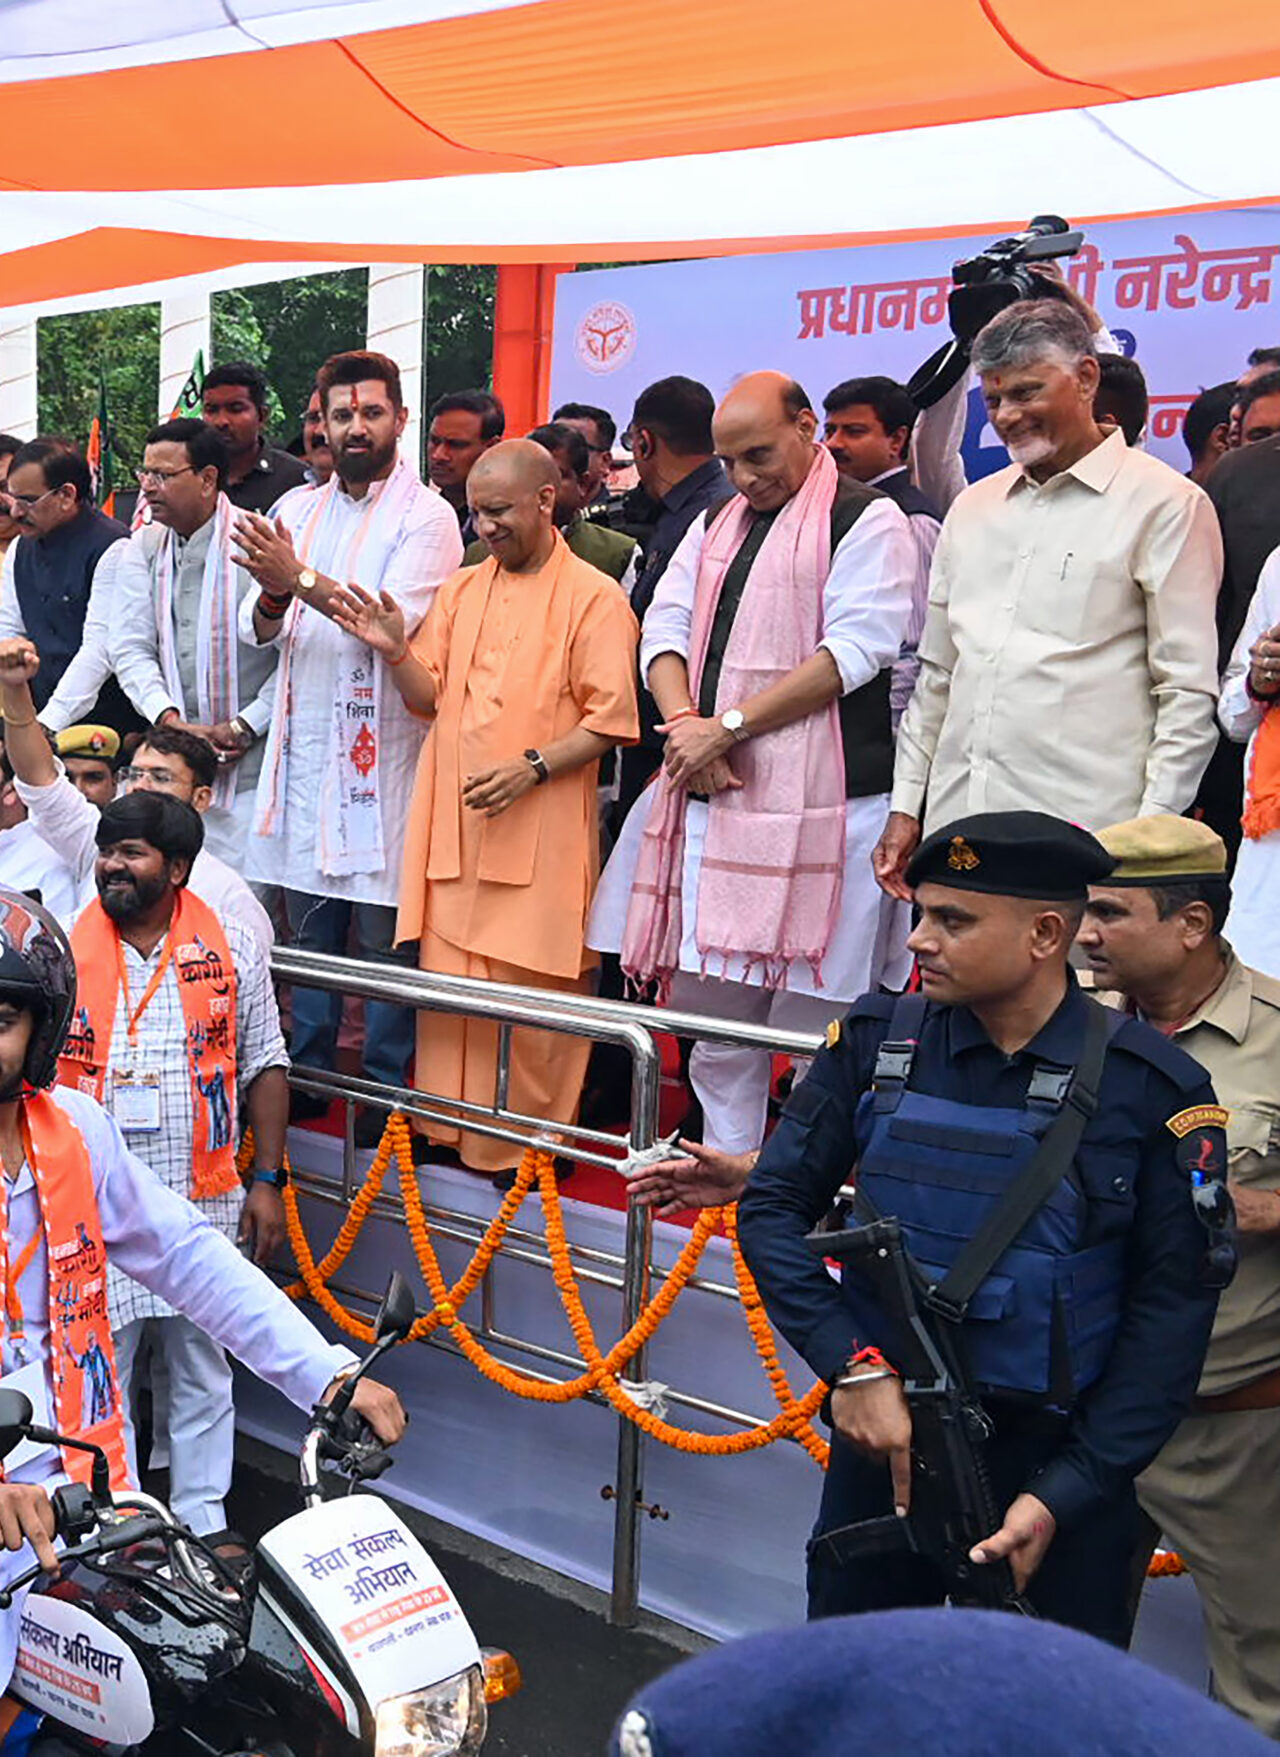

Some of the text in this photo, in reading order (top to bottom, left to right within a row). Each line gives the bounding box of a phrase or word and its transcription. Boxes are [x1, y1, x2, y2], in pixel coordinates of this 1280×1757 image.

[797, 277, 949, 339] प्रधानम
[1112, 234, 1276, 312] नरेन्द्र
[346, 701, 375, 719] शिवा
[353, 687, 373, 699] नम
[303, 1529, 408, 1580] सेवा संकल्प
[344, 1561, 418, 1605] अभियान
[63, 1631, 124, 1682] अभियान
